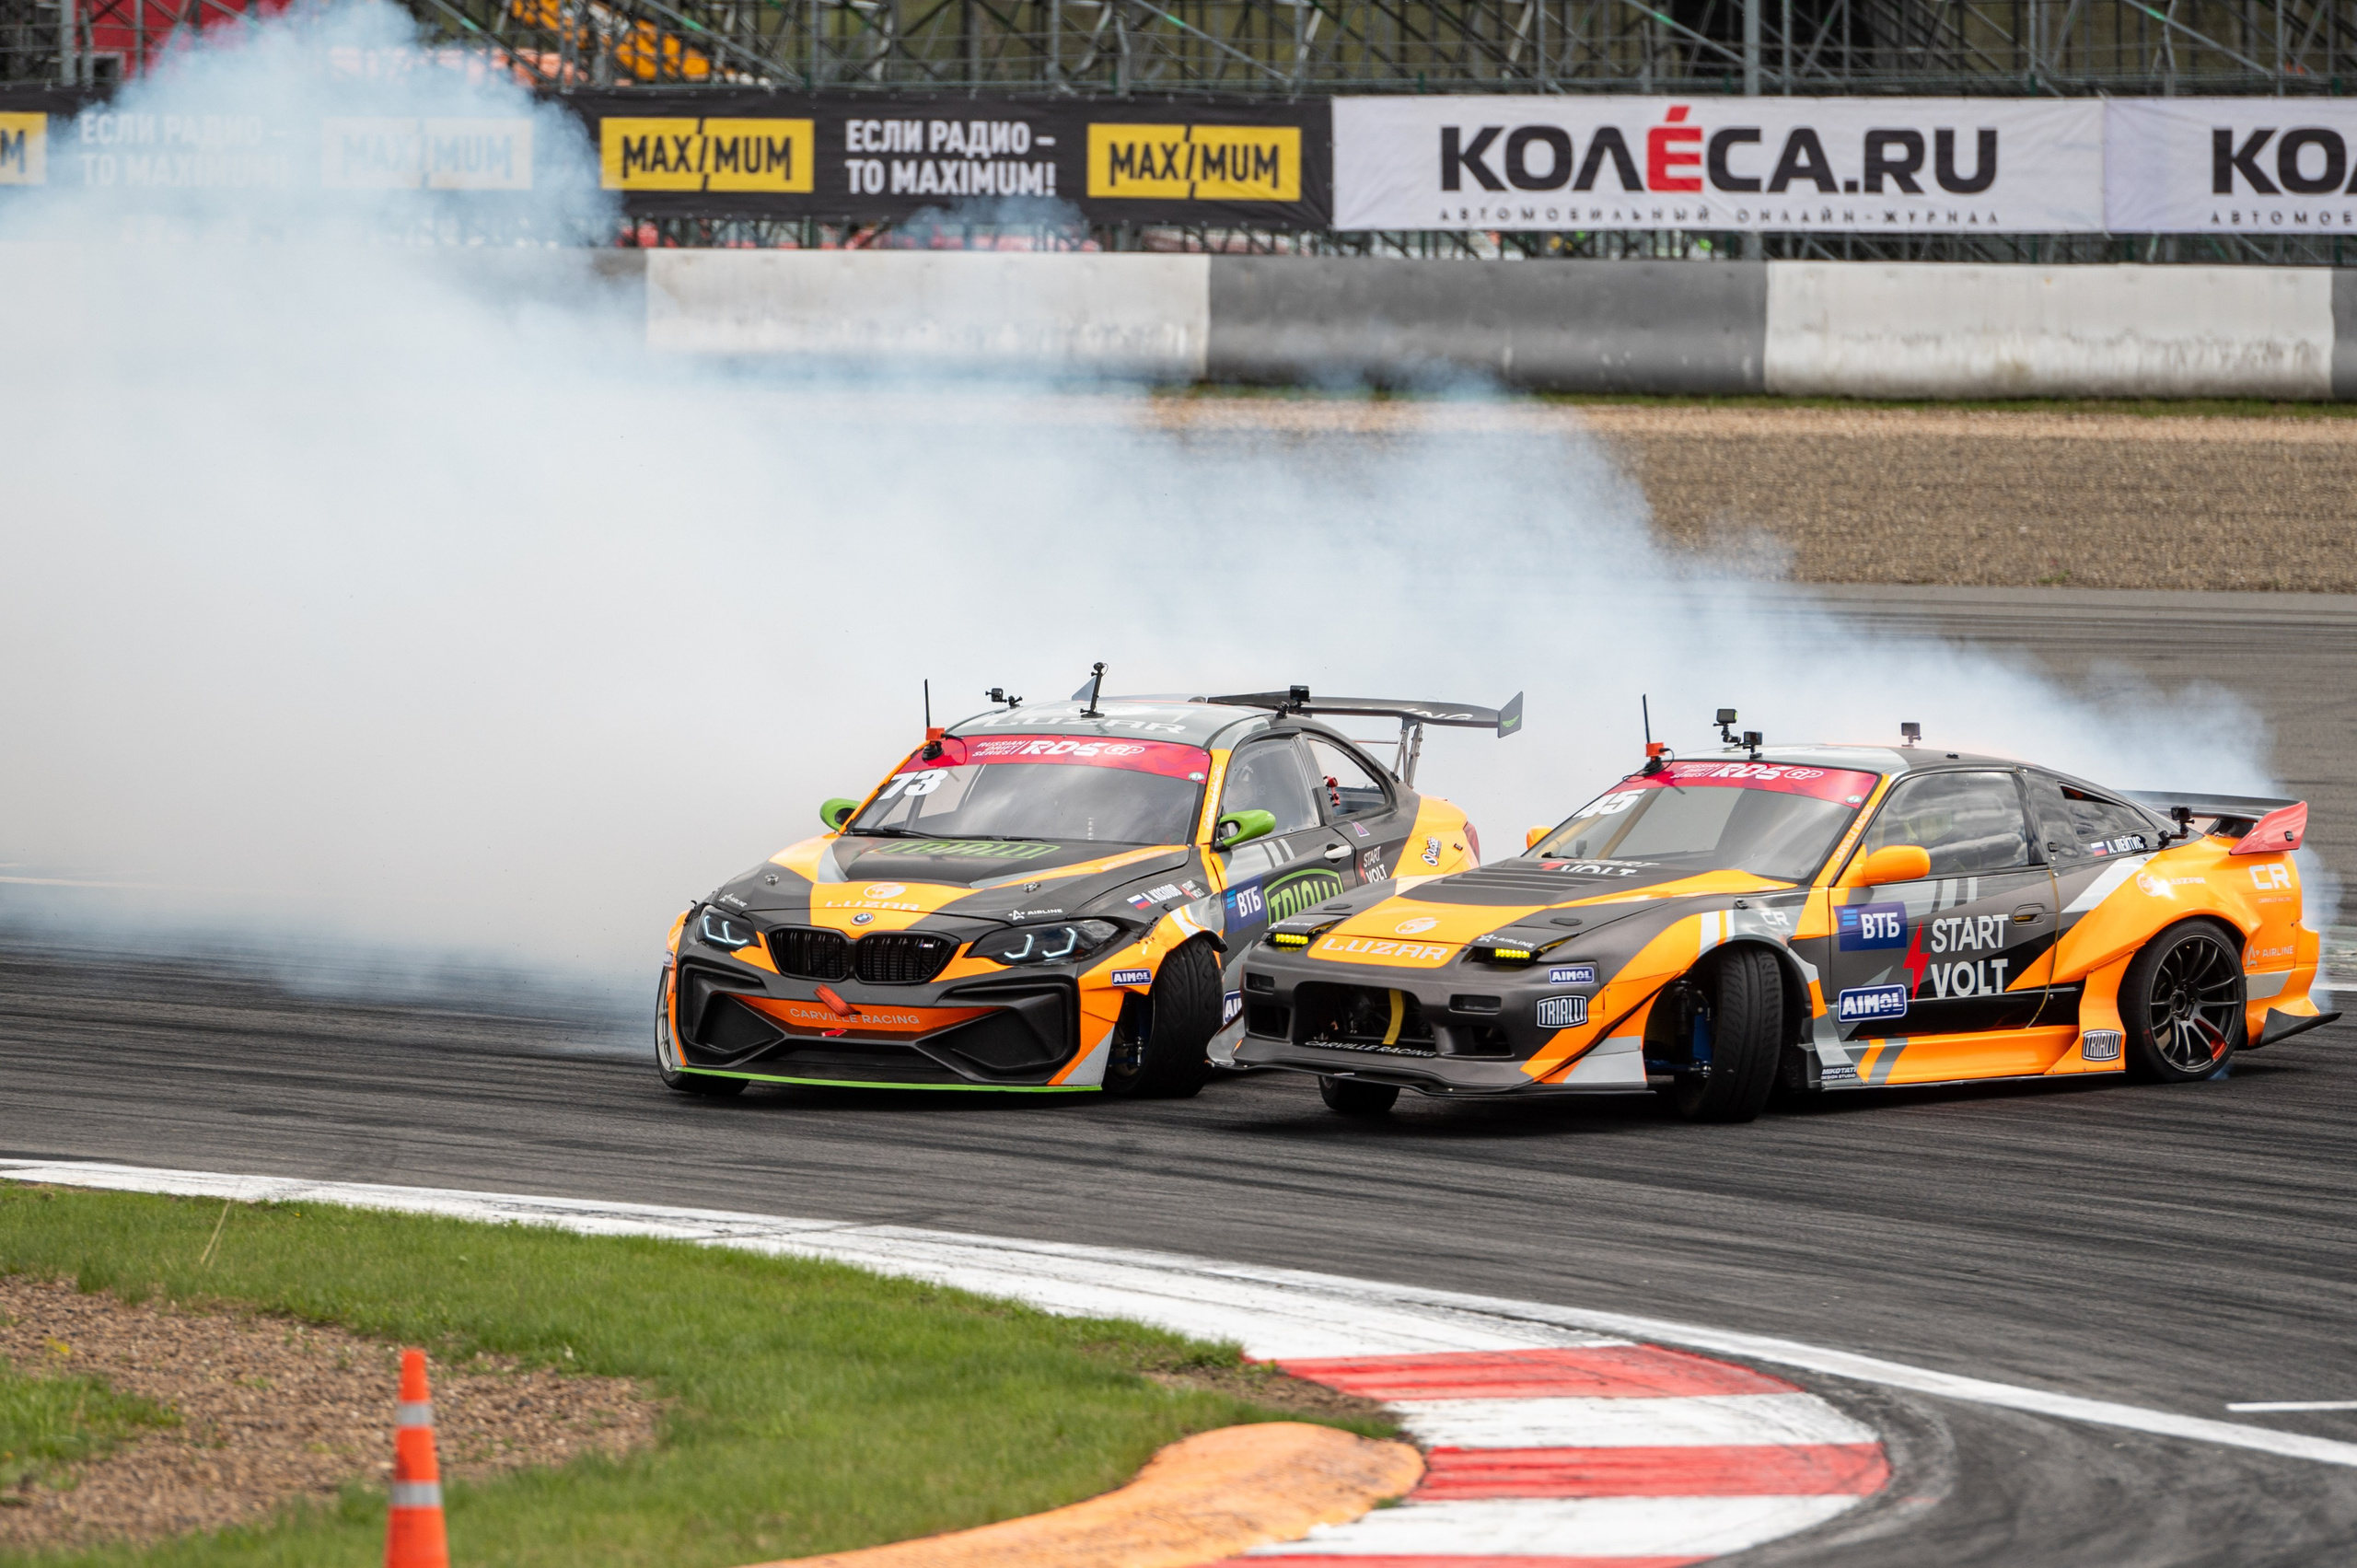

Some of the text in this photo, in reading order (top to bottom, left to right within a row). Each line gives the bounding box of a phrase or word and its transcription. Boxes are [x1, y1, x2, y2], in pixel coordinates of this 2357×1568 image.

[80, 112, 156, 144] ЕСЛИ
[845, 120, 922, 153] ЕСЛИ
[928, 121, 1031, 158] РАДИО
[845, 159, 1056, 197] ТО MAXIMUM!
[1440, 205, 1709, 223] АВТОМОБИЛЬНЫЙ
[982, 717, 1187, 735] LUZAR
[1018, 740, 1145, 757] RDS GP
[1709, 763, 1794, 780] RDS
[877, 769, 949, 801] 73
[1573, 788, 1649, 819] 45
[1363, 846, 1382, 868] START
[1365, 864, 1388, 884] VOLT
[2248, 863, 2293, 890] CR
[825, 900, 920, 912] LUZAR
[1027, 908, 1063, 916] AIRLINE
[1237, 886, 1261, 918] ВТБ
[1759, 911, 1791, 926] CR
[1861, 912, 1900, 940] ВТБ
[1498, 936, 1537, 948] AIRLINE
[1931, 914, 2009, 954] START
[1322, 937, 1449, 961] LUZAR
[2262, 946, 2294, 958] AIRLINE
[1113, 972, 1150, 982] AIMOL
[1551, 970, 1592, 981] AIMOL
[1931, 958, 2009, 999] VOLT
[1539, 998, 1585, 1025] TRIALLI
[1841, 992, 1904, 1016] AIMOL
[861, 1014, 920, 1024] RACING
[1305, 1040, 1438, 1058] CARVILLE RACING
[2086, 1032, 2119, 1057] TRIALLI
